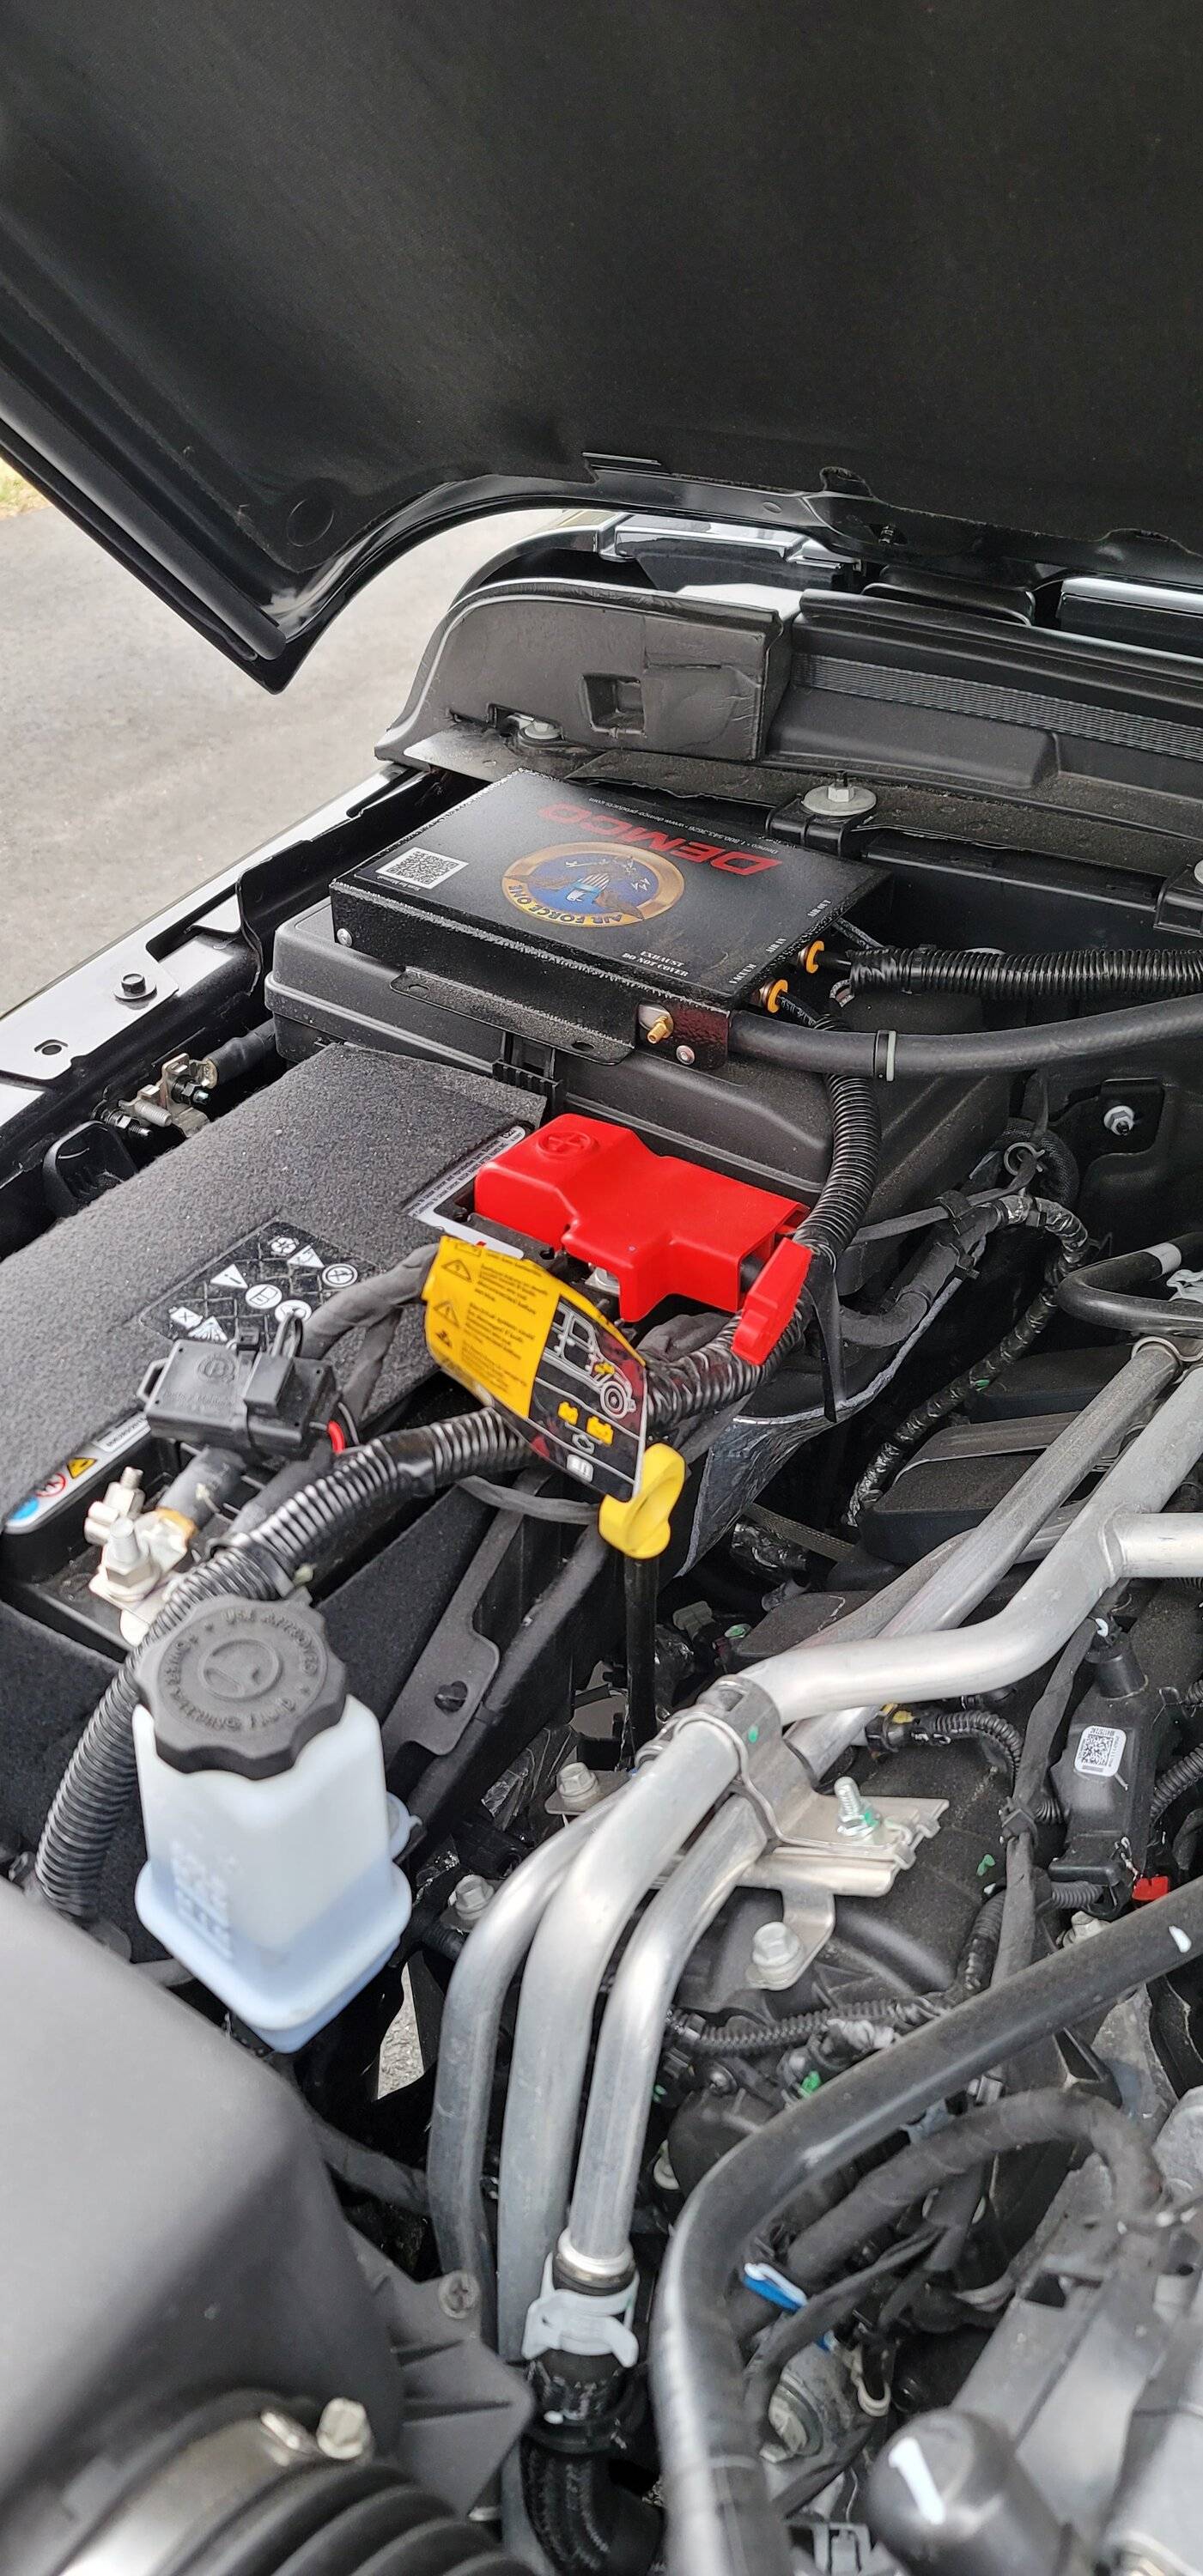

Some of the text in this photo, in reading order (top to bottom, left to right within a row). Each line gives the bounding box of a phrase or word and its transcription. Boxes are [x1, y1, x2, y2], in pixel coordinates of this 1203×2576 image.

[538, 802, 783, 876] DEMCO
[508, 884, 622, 924] AIR FORCE ONE
[622, 952, 689, 977] DO NOT COVER
[640, 951, 685, 968] EXHAUST
